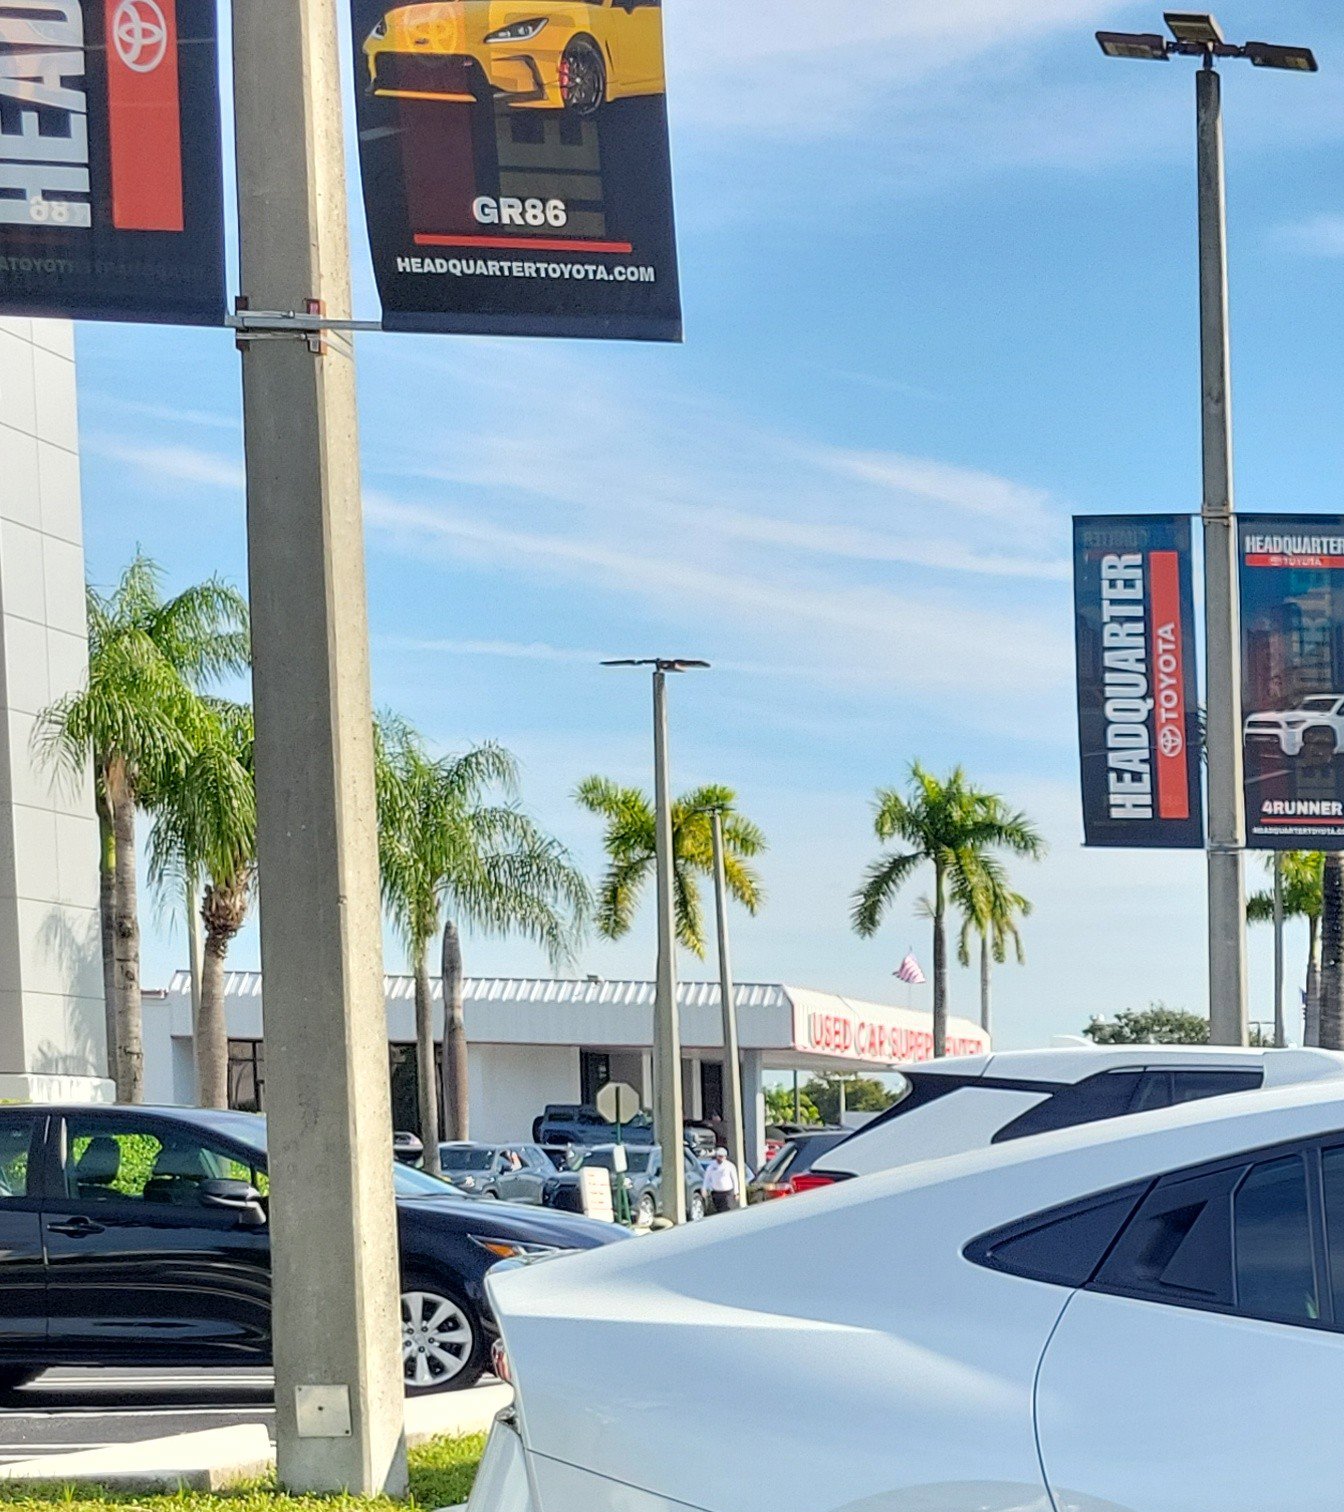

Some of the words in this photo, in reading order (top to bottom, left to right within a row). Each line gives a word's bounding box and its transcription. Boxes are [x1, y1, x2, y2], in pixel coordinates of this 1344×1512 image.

[473, 196, 567, 227] GR86
[396, 257, 655, 283] HEADQUARTERTOYOTA.COM
[1101, 552, 1153, 819] HEADQUARTER
[1157, 621, 1179, 723] TOYOTA
[1261, 800, 1343, 816] 4RUNNER
[811, 1011, 852, 1050] USED
[855, 1020, 886, 1056] CAR
